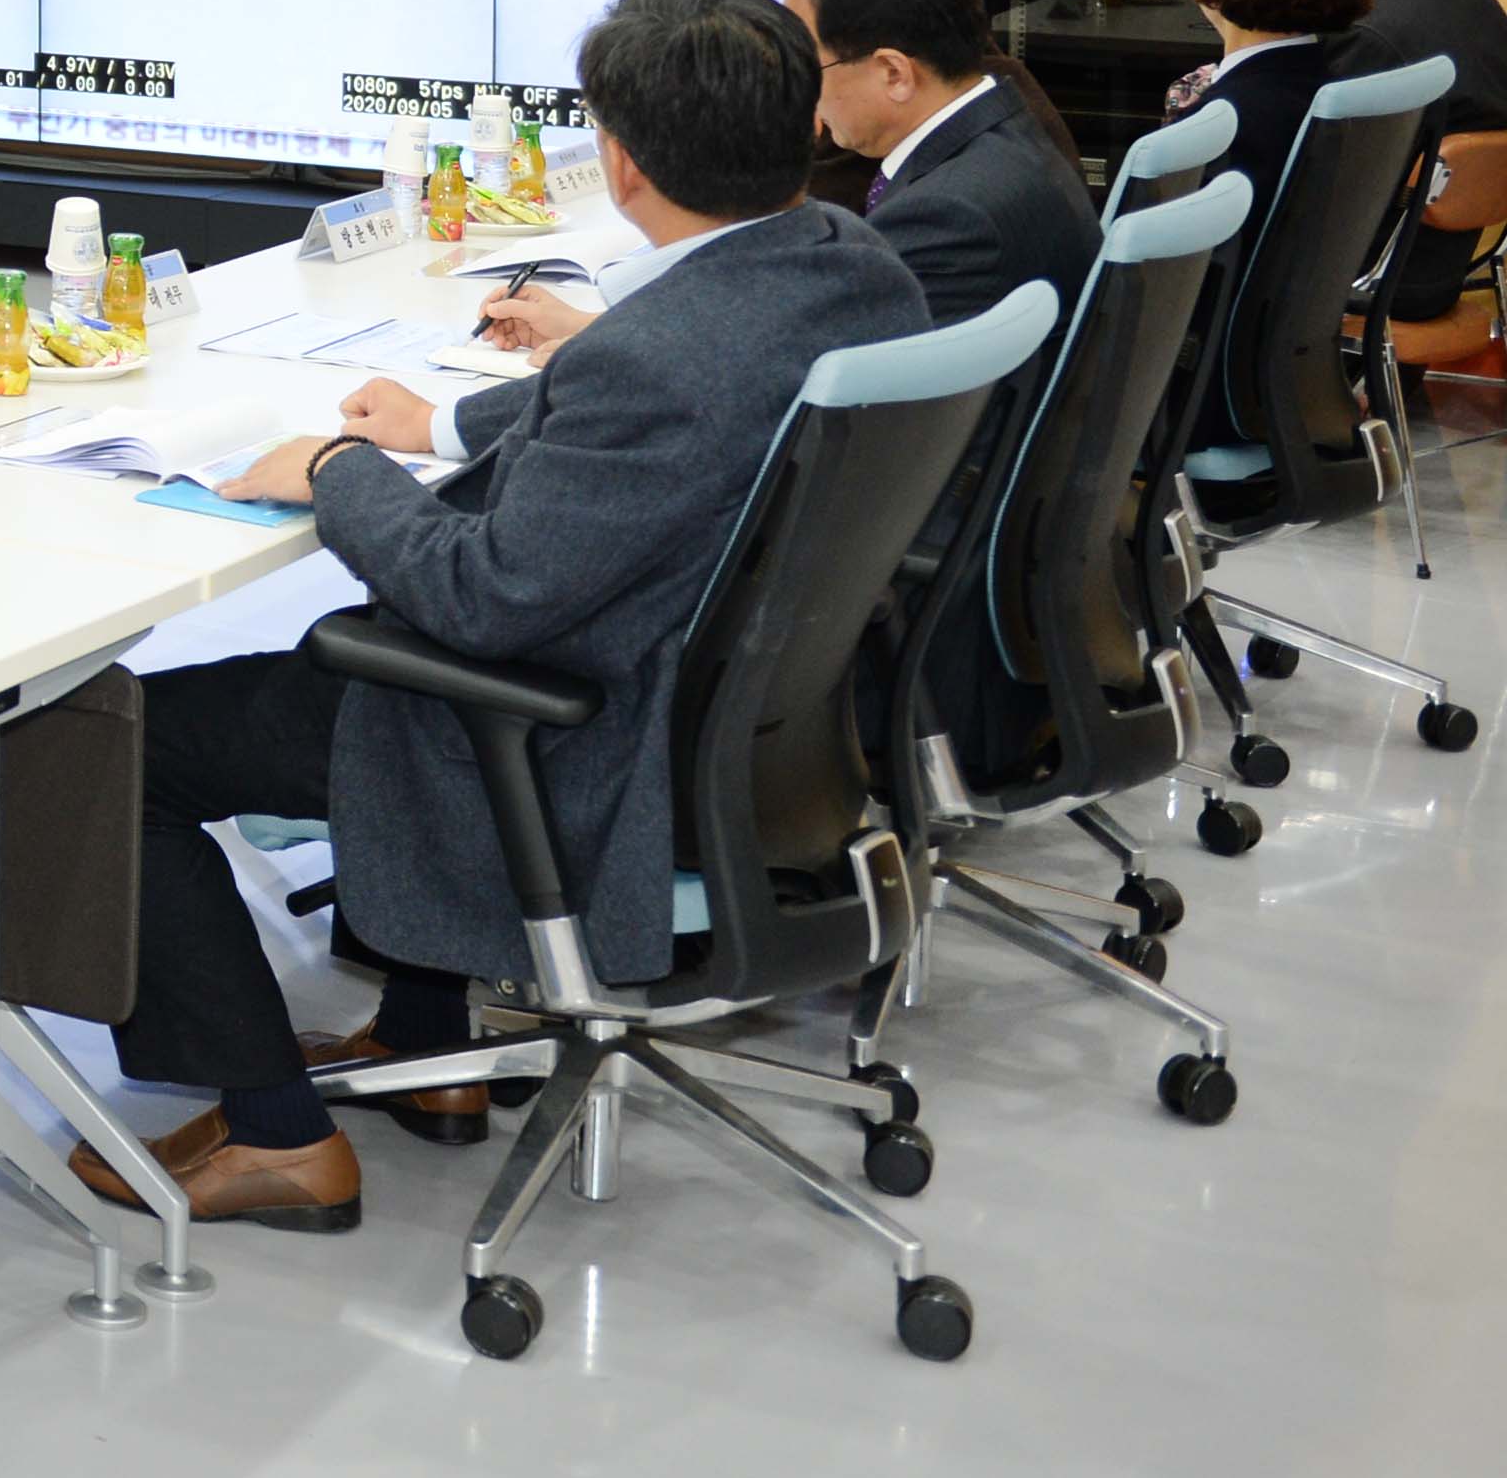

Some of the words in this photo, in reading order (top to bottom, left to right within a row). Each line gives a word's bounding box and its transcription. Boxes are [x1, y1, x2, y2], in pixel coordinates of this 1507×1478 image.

[46, 55, 97, 74] 4.97V
[124, 60, 175, 80] 5.03V
[56, 74, 96, 93] 0.00
[124, 80, 167, 98] 0.00
[343, 75, 398, 96] 1080p
[418, 80, 464, 100] 5fps
[522, 87, 558, 106] OFF
[342, 94, 453, 119] 2020/09/05
